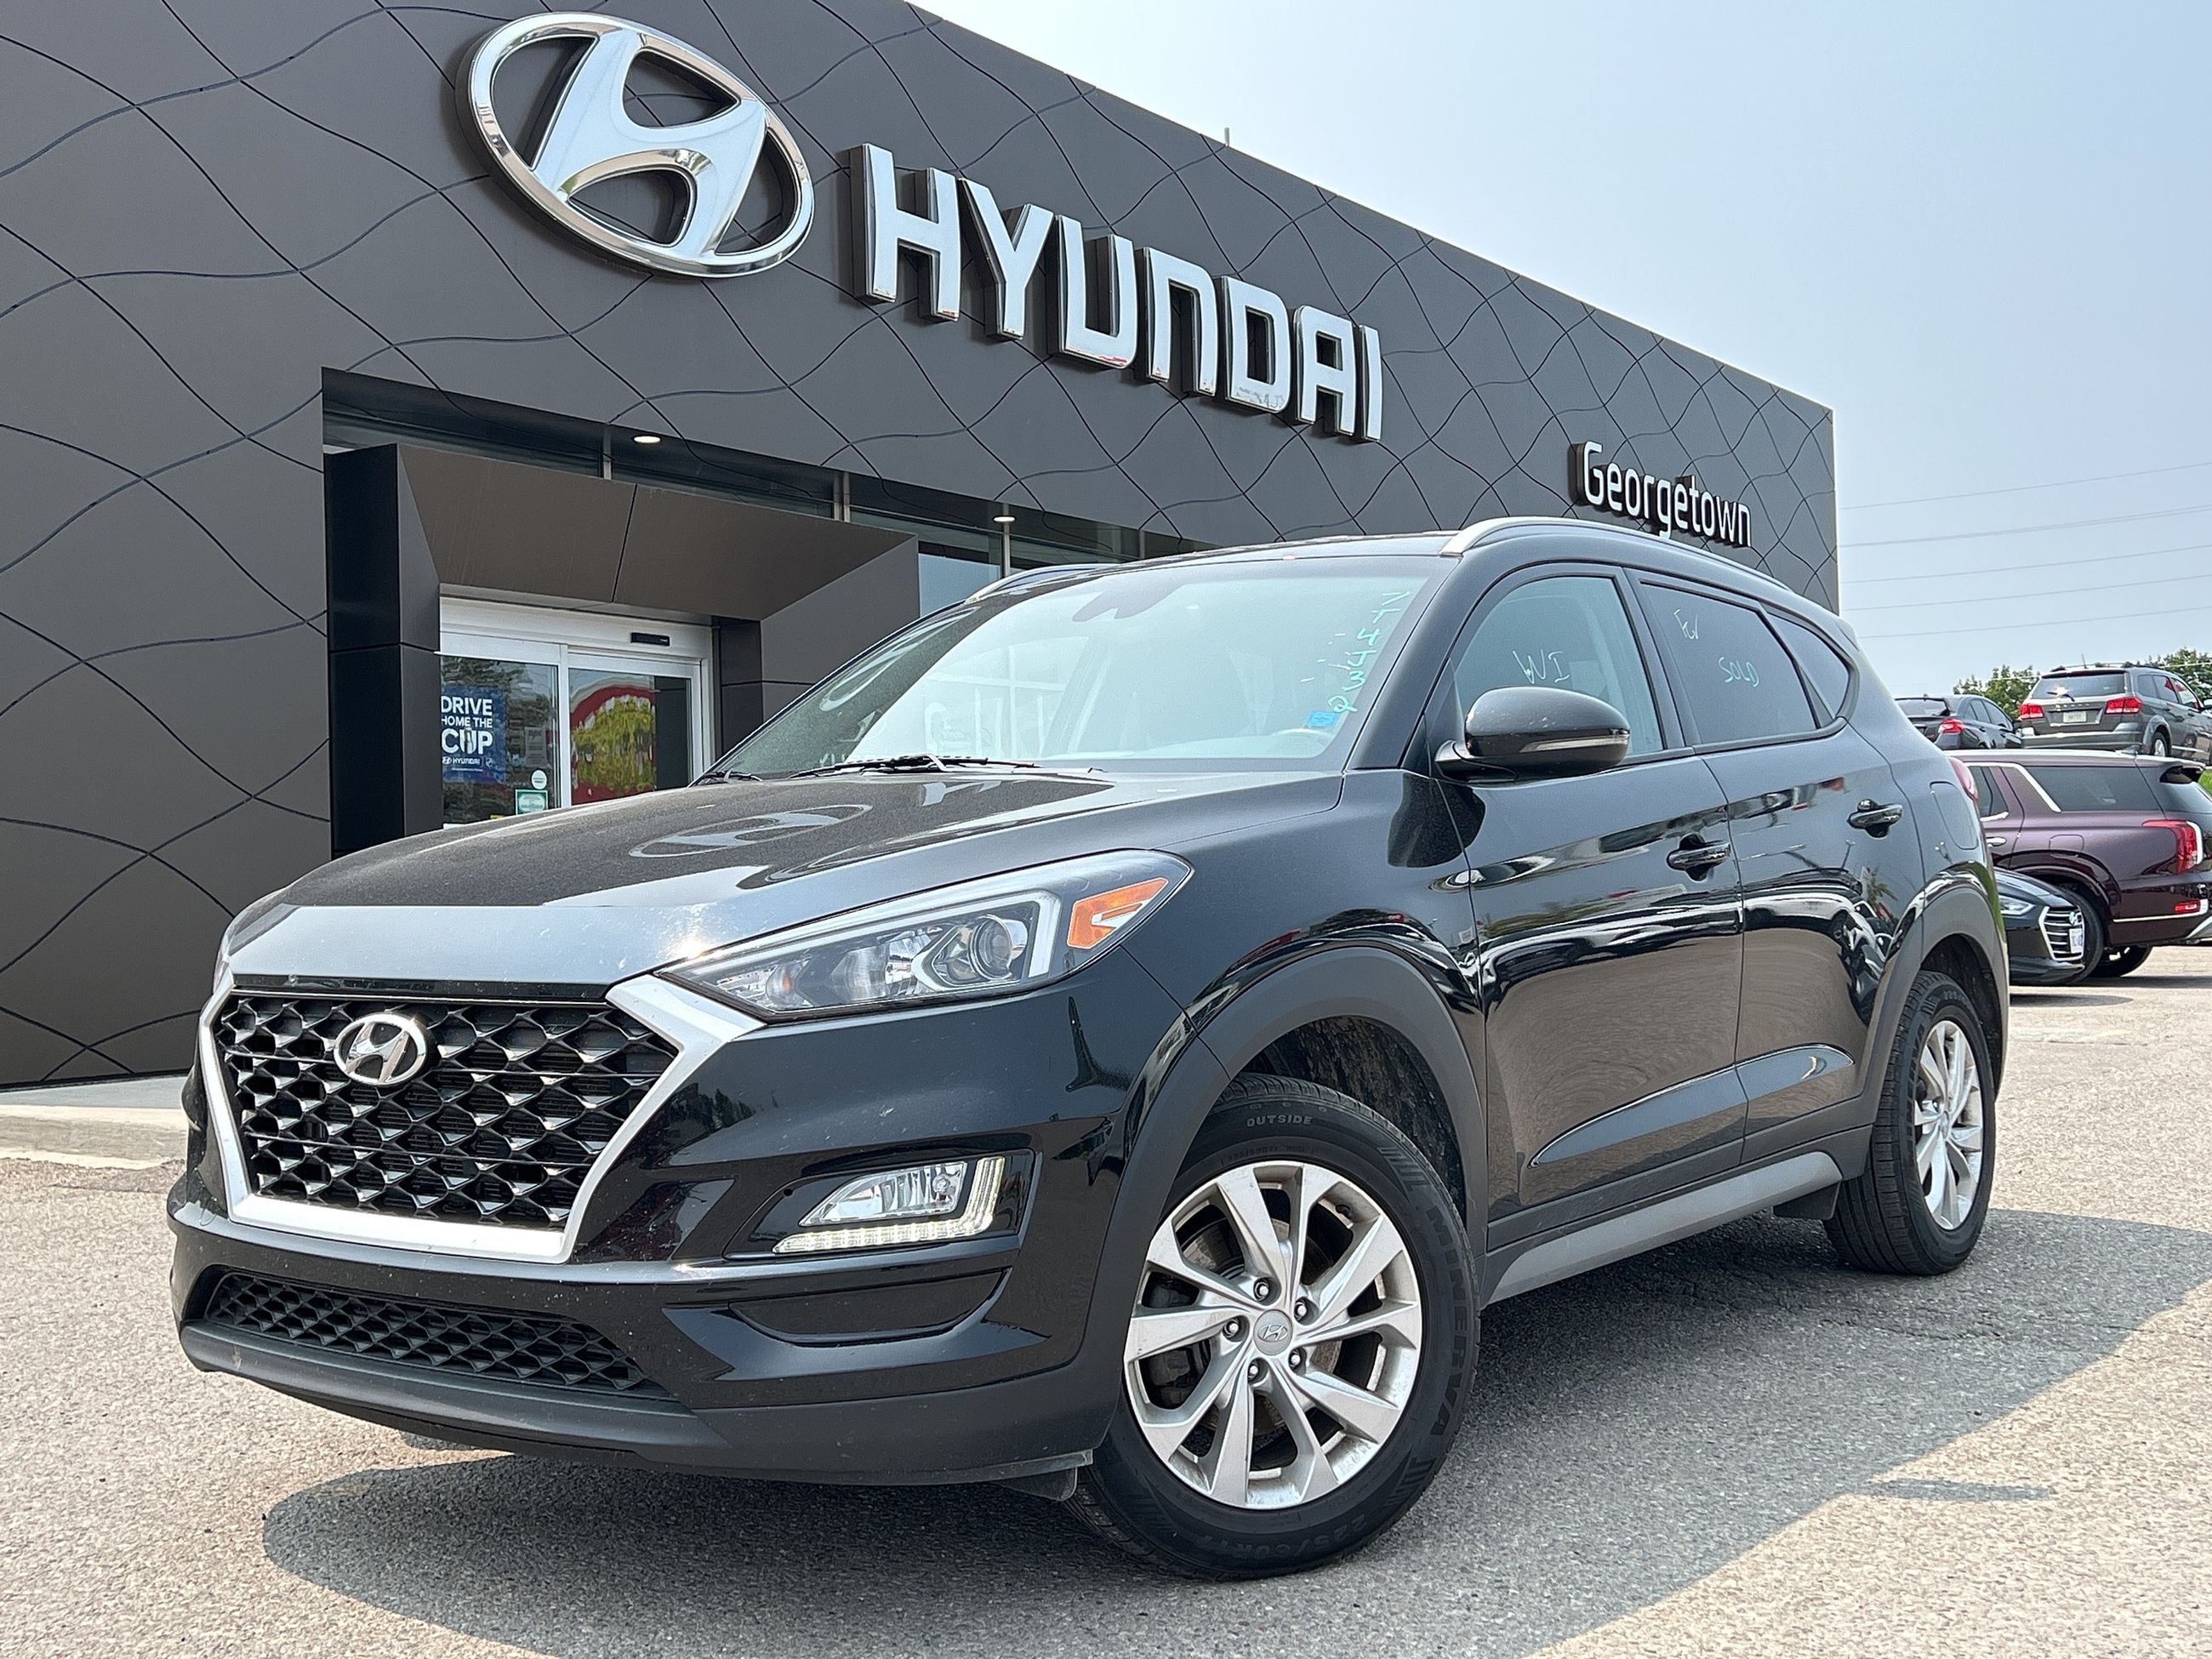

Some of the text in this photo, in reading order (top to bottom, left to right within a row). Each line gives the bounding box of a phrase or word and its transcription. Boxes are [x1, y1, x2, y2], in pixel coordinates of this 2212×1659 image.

[861, 142, 1383, 442] HYUNDAI
[1582, 441, 1752, 547] Georgetown
[1718, 656, 1759, 687] SOLD
[441, 695, 493, 716] DRIVE
[441, 715, 493, 728] HOME THE
[441, 727, 493, 755] CUP
[1246, 1113, 1313, 1127] OUTSIDE
[1426, 1204, 1468, 1436] MINERVA
